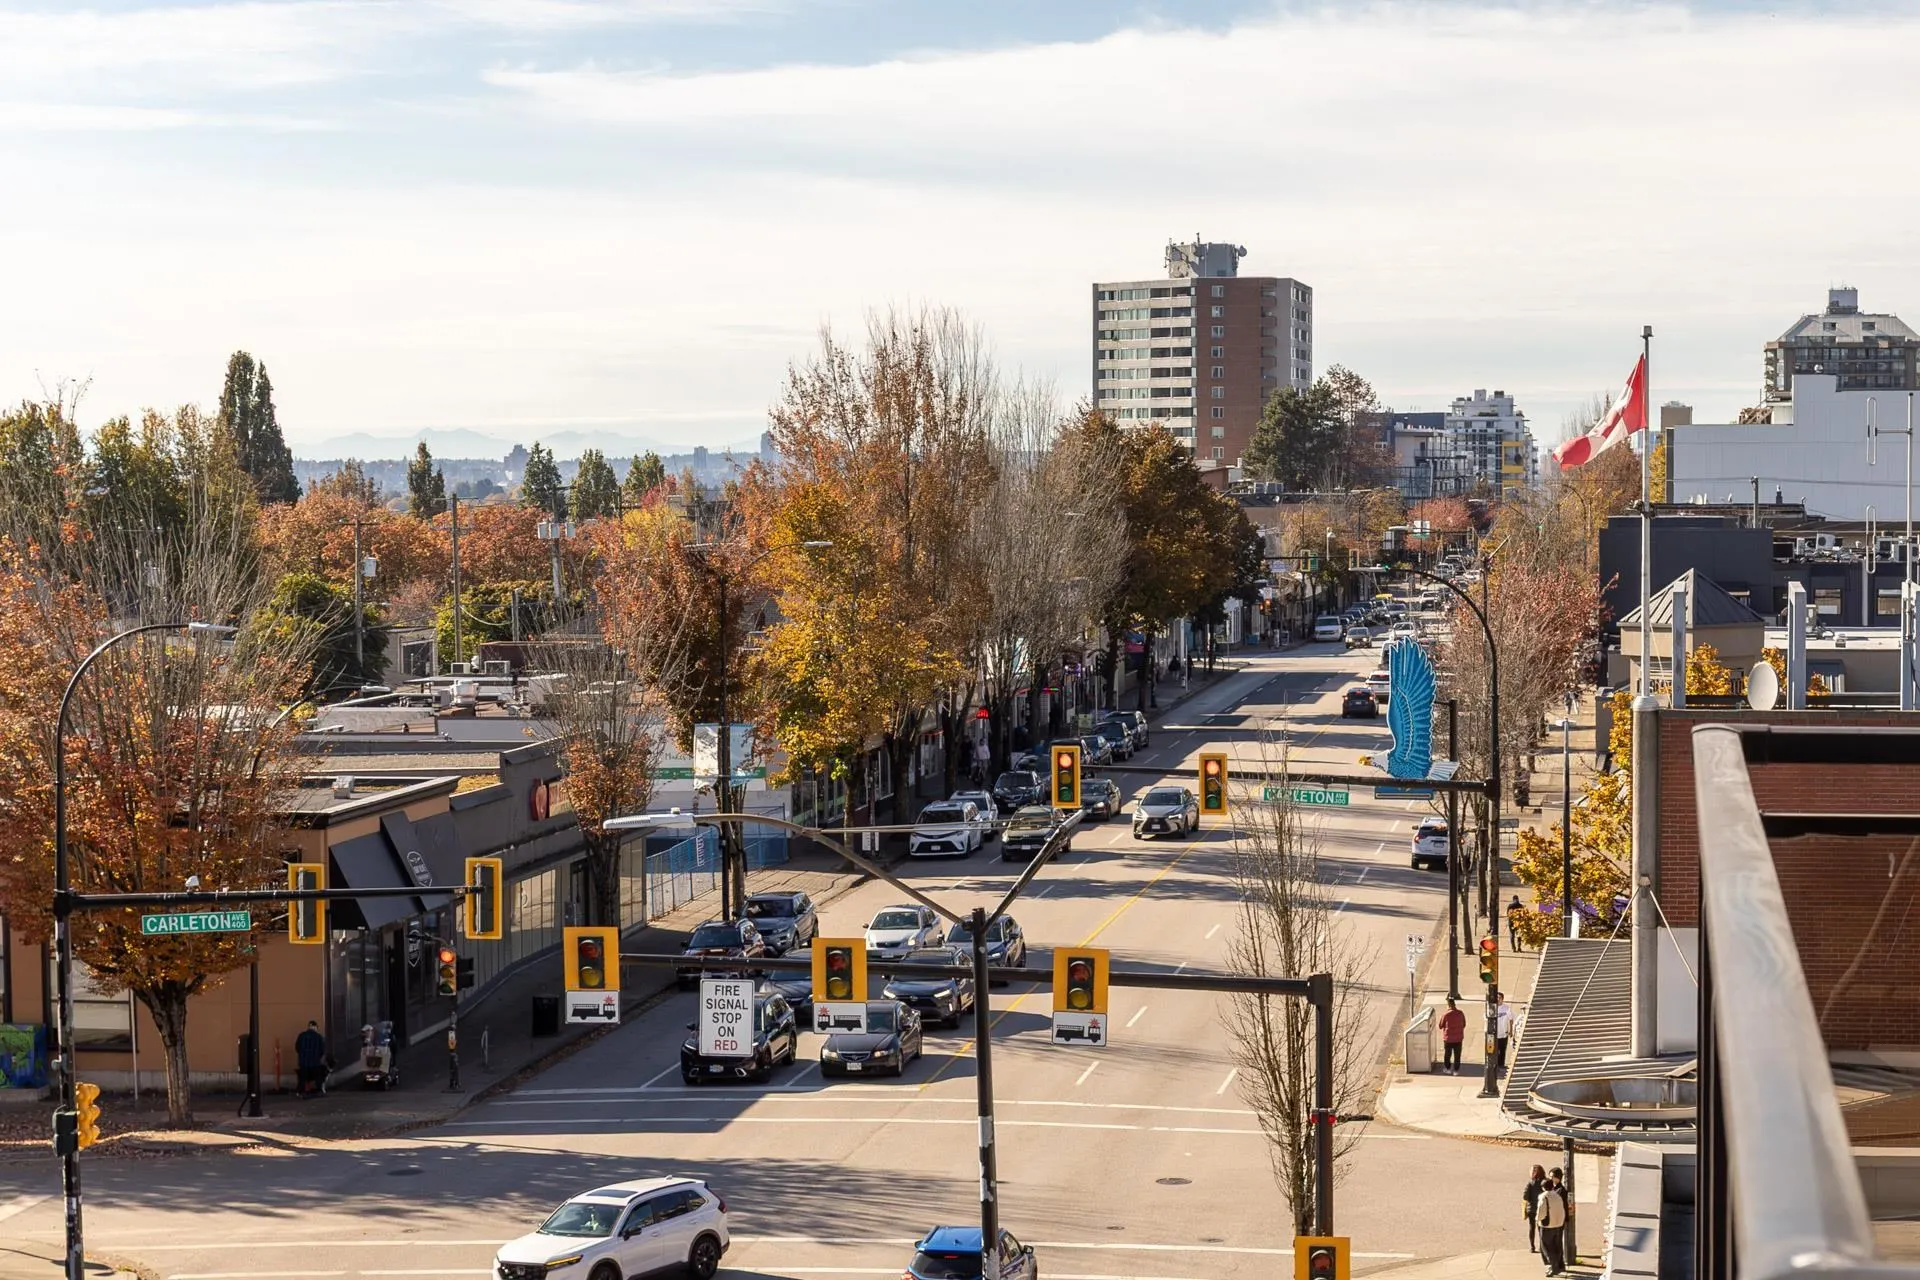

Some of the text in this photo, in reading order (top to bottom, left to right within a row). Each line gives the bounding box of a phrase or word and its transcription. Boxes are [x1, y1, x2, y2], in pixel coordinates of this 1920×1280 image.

[146, 914, 231, 932] CARLETON
[714, 985, 740, 996] FIRE
[706, 998, 748, 1010] SIGNAL
[712, 1012, 742, 1023] STOP
[718, 1026, 735, 1037] ON
[714, 1040, 738, 1051] RED
